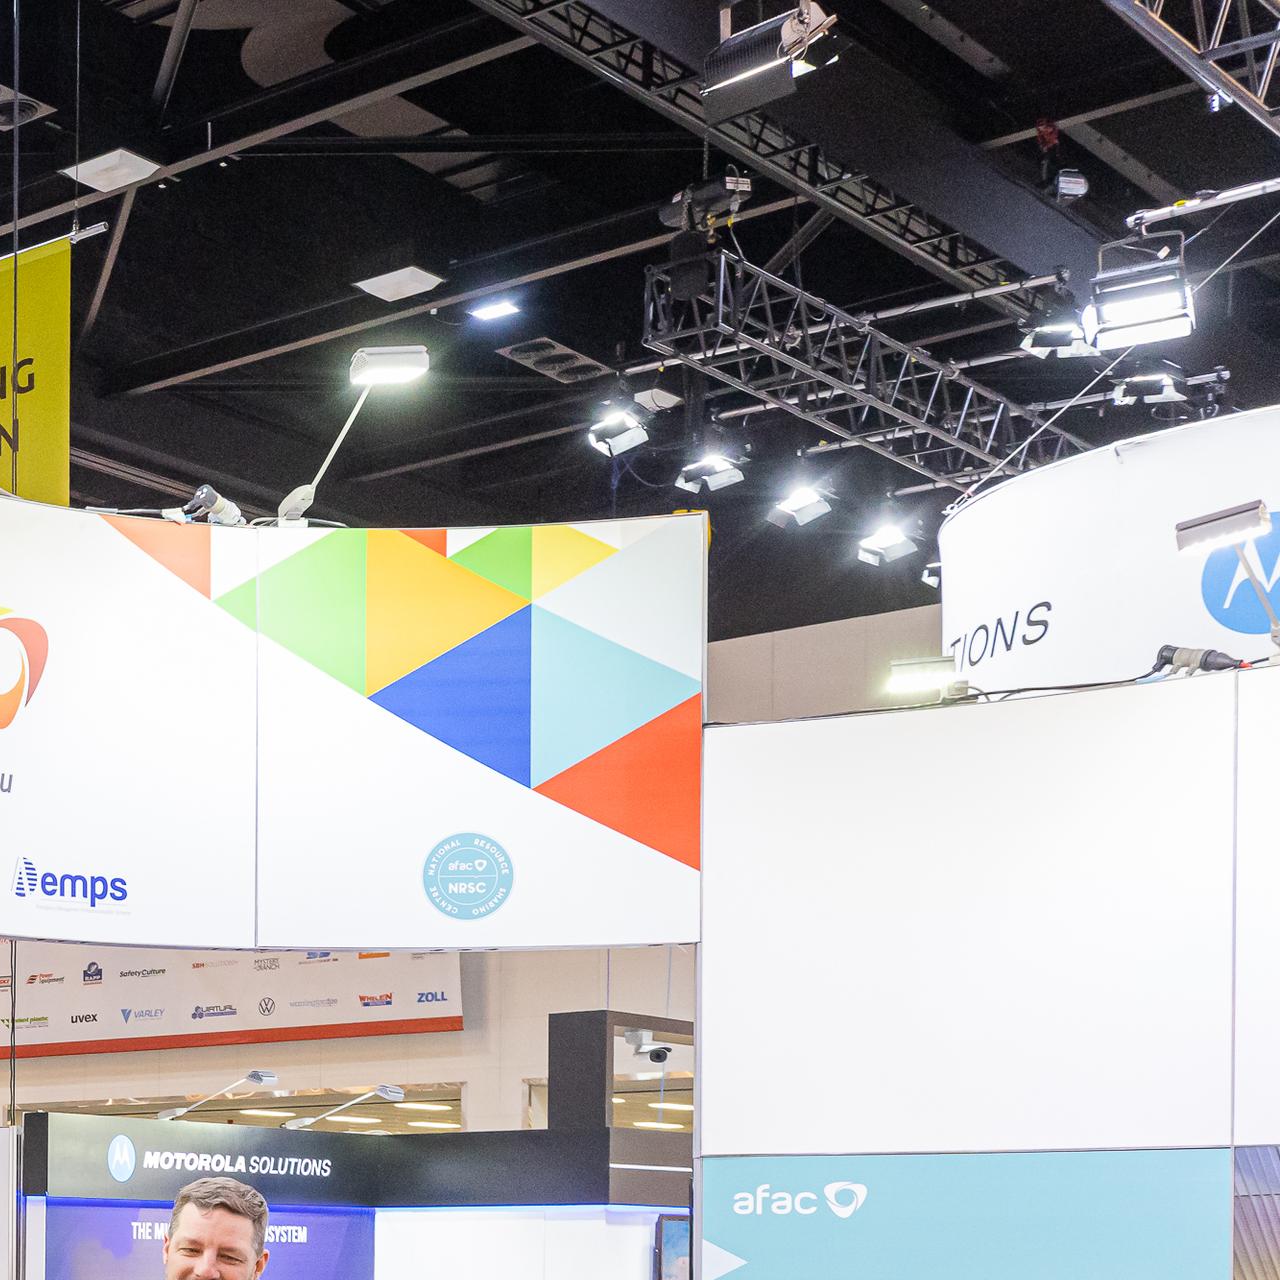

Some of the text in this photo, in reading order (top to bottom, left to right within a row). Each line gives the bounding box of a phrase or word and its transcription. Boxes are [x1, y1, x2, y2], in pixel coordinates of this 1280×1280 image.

[448, 861, 473, 870] afac
[41, 872, 128, 907] emps
[448, 882, 486, 894] NRSC
[417, 991, 447, 1002] ZOLL
[71, 1013, 98, 1024] uvex
[134, 1009, 165, 1017] VARLEY
[143, 1151, 332, 1177] MOTOROLA SOLUTIONS
[732, 1183, 818, 1216] afac
[131, 1222, 153, 1240] THE
